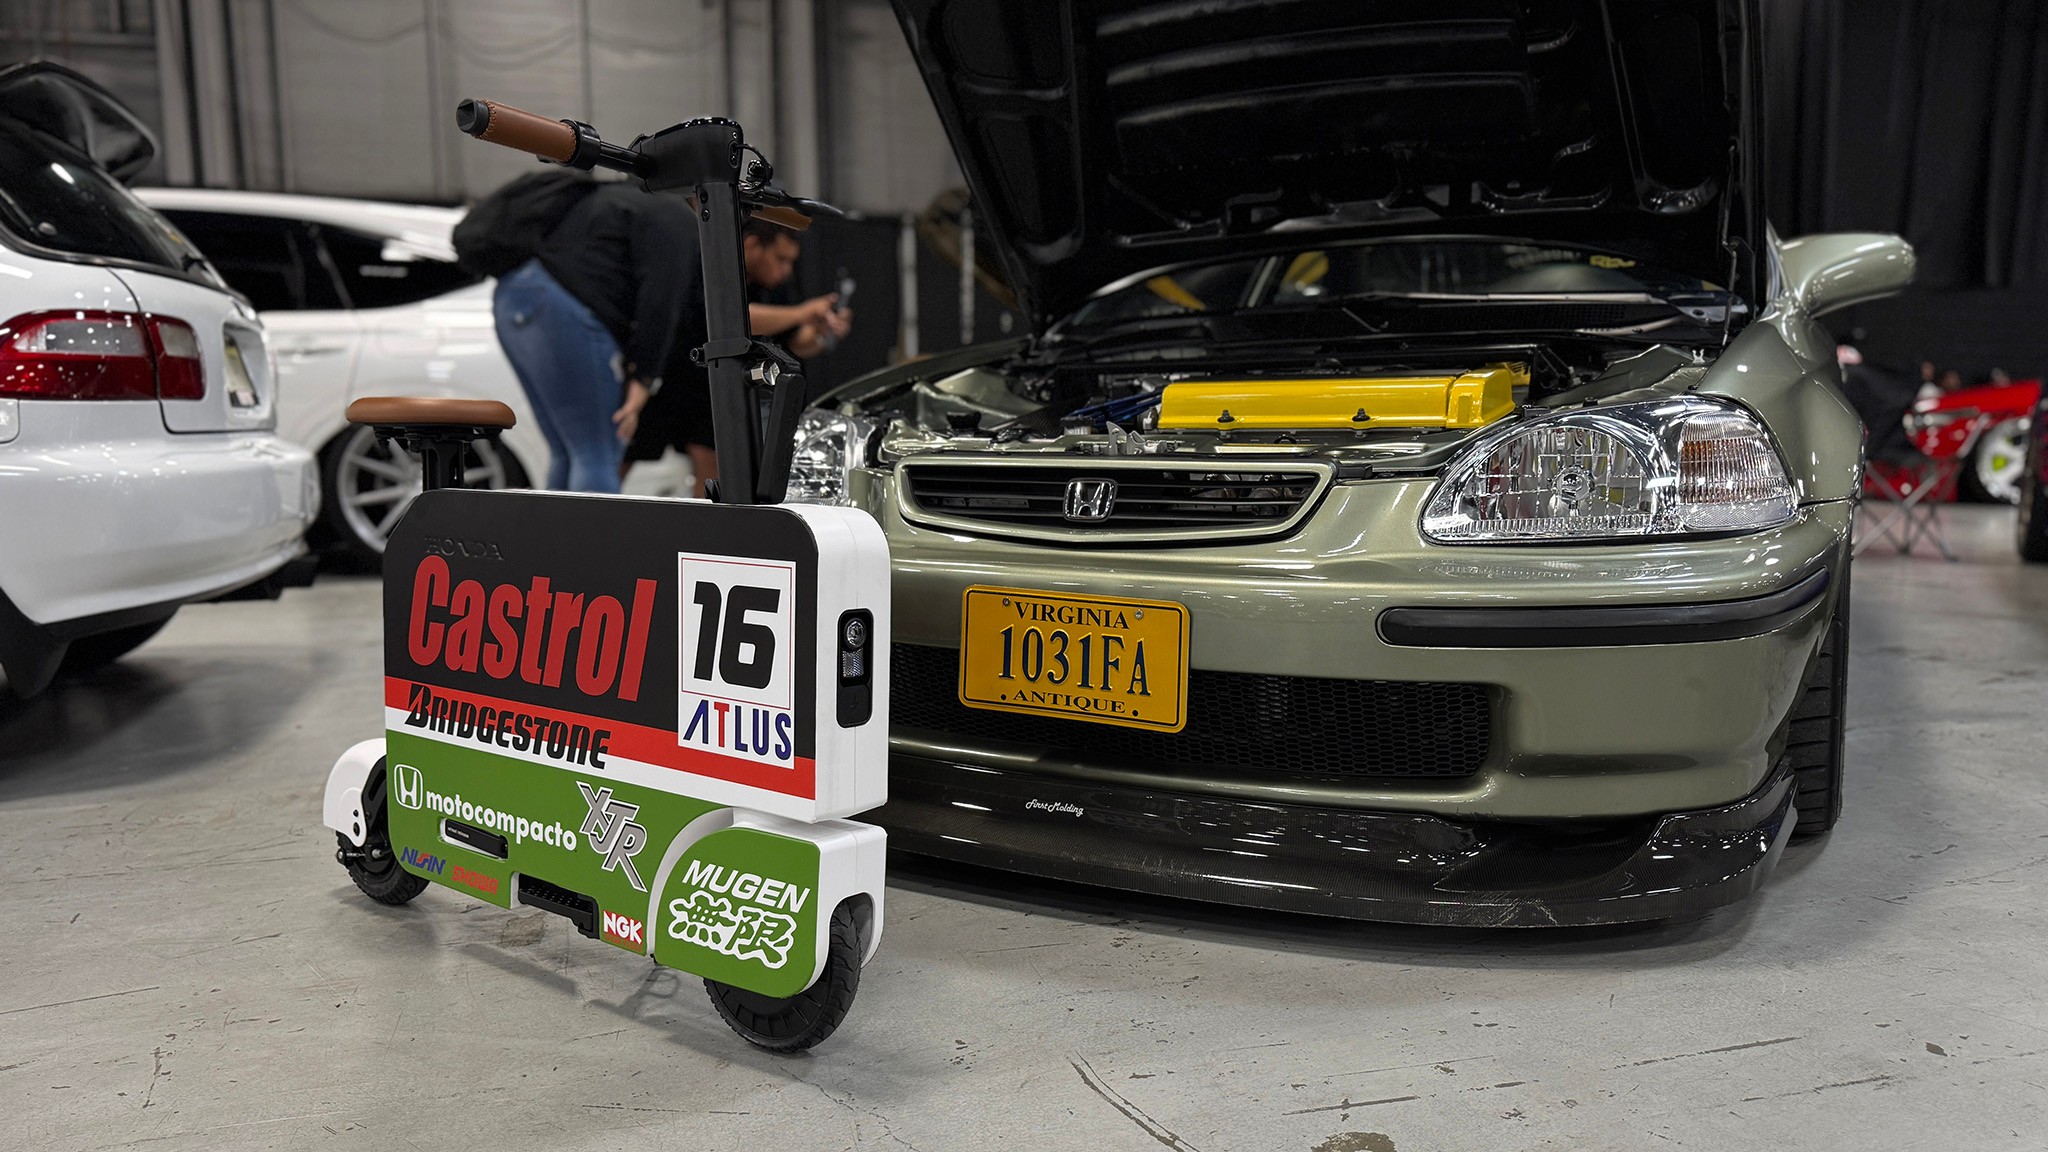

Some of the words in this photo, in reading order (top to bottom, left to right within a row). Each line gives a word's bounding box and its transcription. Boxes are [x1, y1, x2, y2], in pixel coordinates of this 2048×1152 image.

[408, 555, 657, 702] Castrol
[693, 581, 781, 690] 16
[1015, 601, 1129, 630] VIRGINIA
[998, 624, 1151, 697] 1031FA
[405, 684, 612, 770] BRIDGESTONE
[683, 699, 792, 761] ATLUS
[1013, 689, 1126, 715] ANTIQUE
[426, 790, 577, 851] motocompacto
[452, 865, 499, 895] SHOWA
[682, 859, 810, 913] MUGEN
[603, 910, 643, 945] NGK
